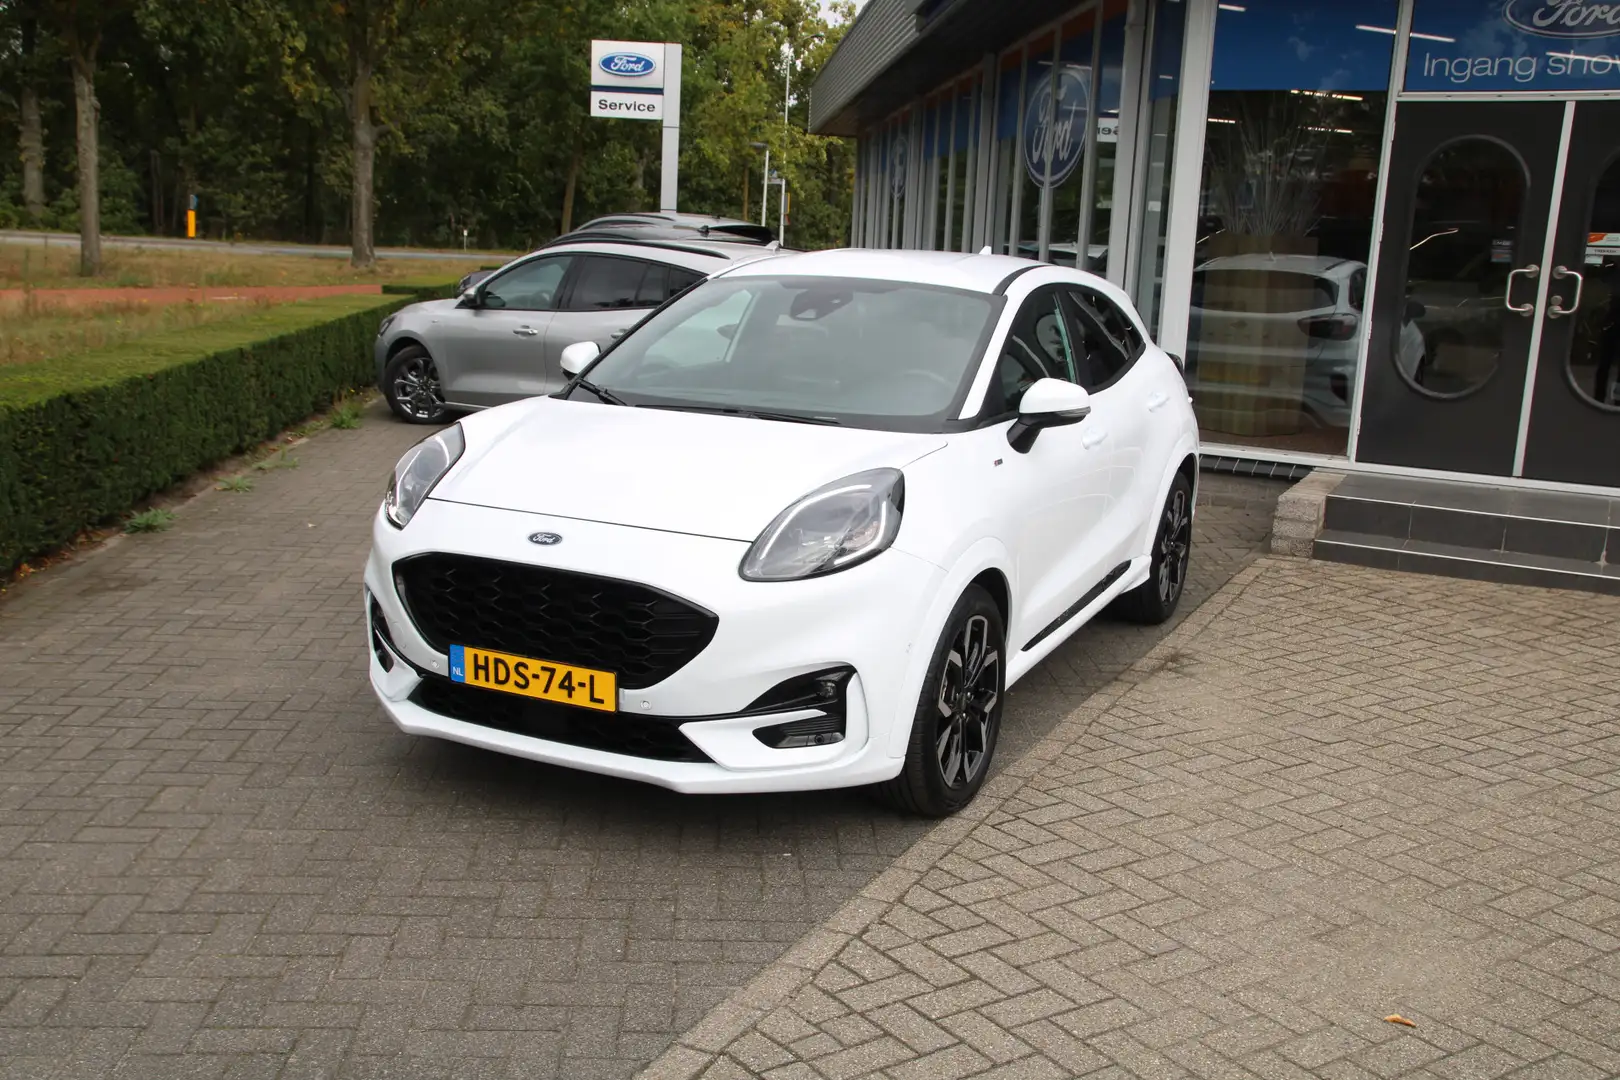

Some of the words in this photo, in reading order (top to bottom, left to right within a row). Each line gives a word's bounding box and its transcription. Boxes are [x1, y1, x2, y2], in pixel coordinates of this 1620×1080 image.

[1532, 0, 1620, 27] For
[610, 55, 645, 72] Ford
[1423, 52, 1538, 83] Ingang
[598, 99, 656, 113] Service
[532, 533, 556, 544] Ford
[452, 666, 464, 677] NL
[473, 653, 605, 705] HDS-74-L
